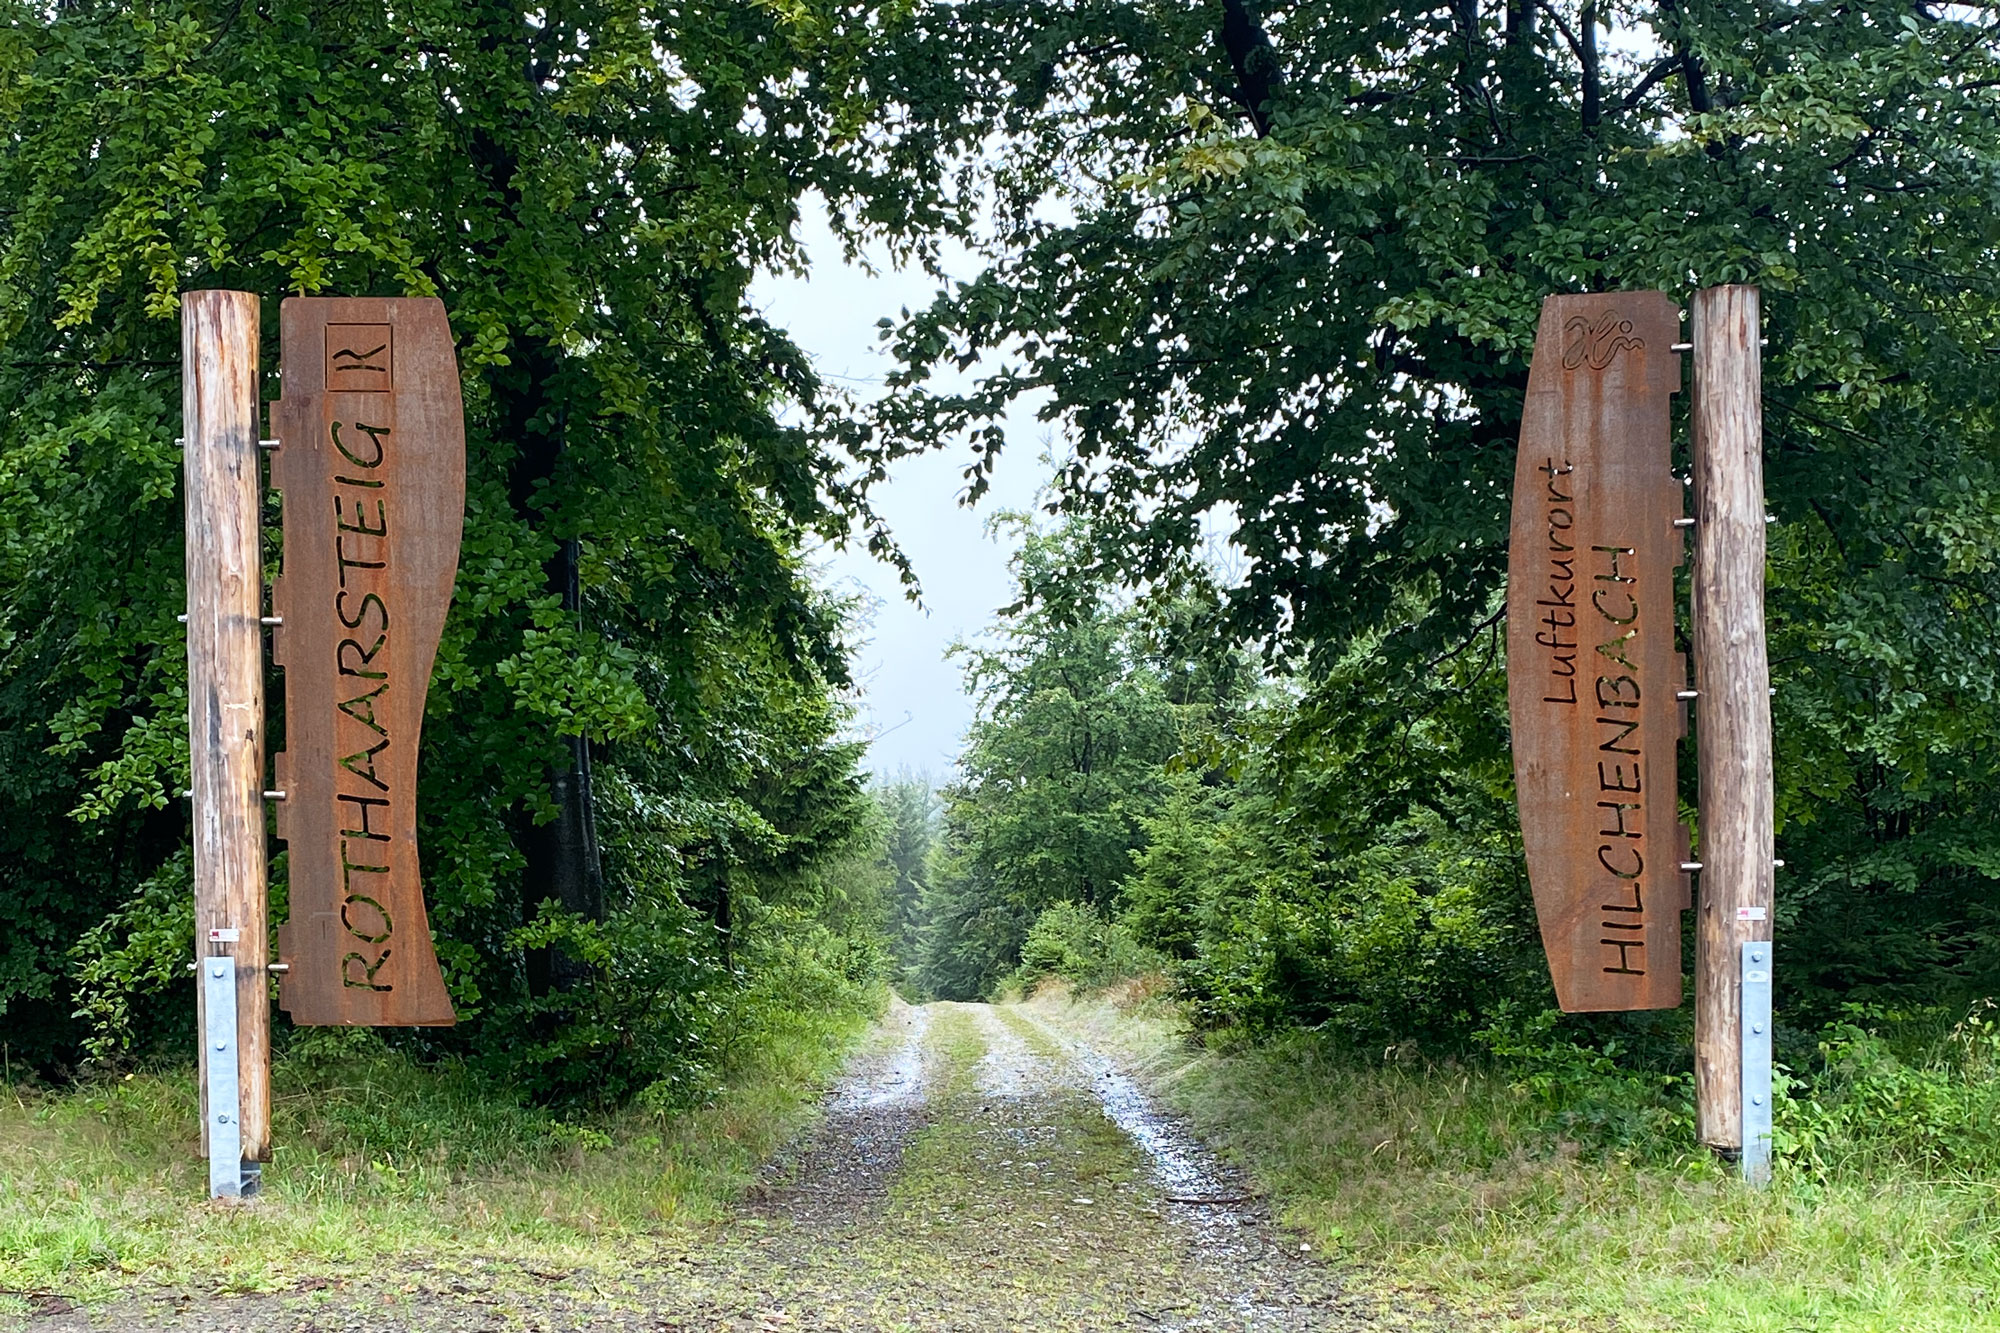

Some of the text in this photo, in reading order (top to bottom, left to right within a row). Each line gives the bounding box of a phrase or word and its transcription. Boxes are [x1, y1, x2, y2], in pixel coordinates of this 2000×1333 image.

[332, 420, 393, 992] ROTHAARSTEIG
[1536, 457, 1577, 705] Luftkurort
[1591, 546, 1645, 976] HILCHENBACH
